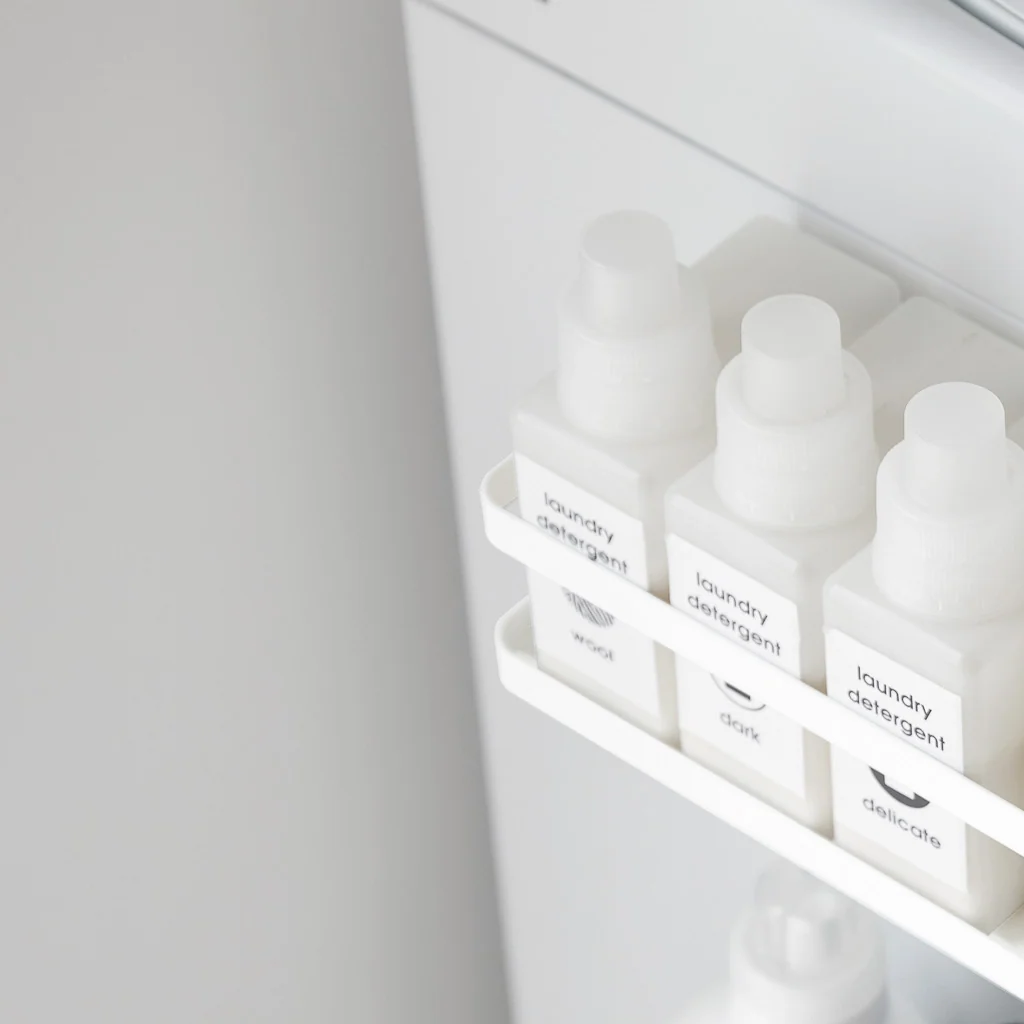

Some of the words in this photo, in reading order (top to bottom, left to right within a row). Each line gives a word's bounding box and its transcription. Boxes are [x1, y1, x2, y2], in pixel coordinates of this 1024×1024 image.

[536, 513, 628, 575] detergent
[544, 492, 614, 544] laundry
[687, 593, 781, 657] detergent
[696, 571, 769, 626] laundry
[571, 630, 614, 662] wool
[847, 687, 946, 752] detergent
[857, 665, 933, 721] laundry
[719, 711, 761, 744] dark
[862, 794, 942, 850] delicate
